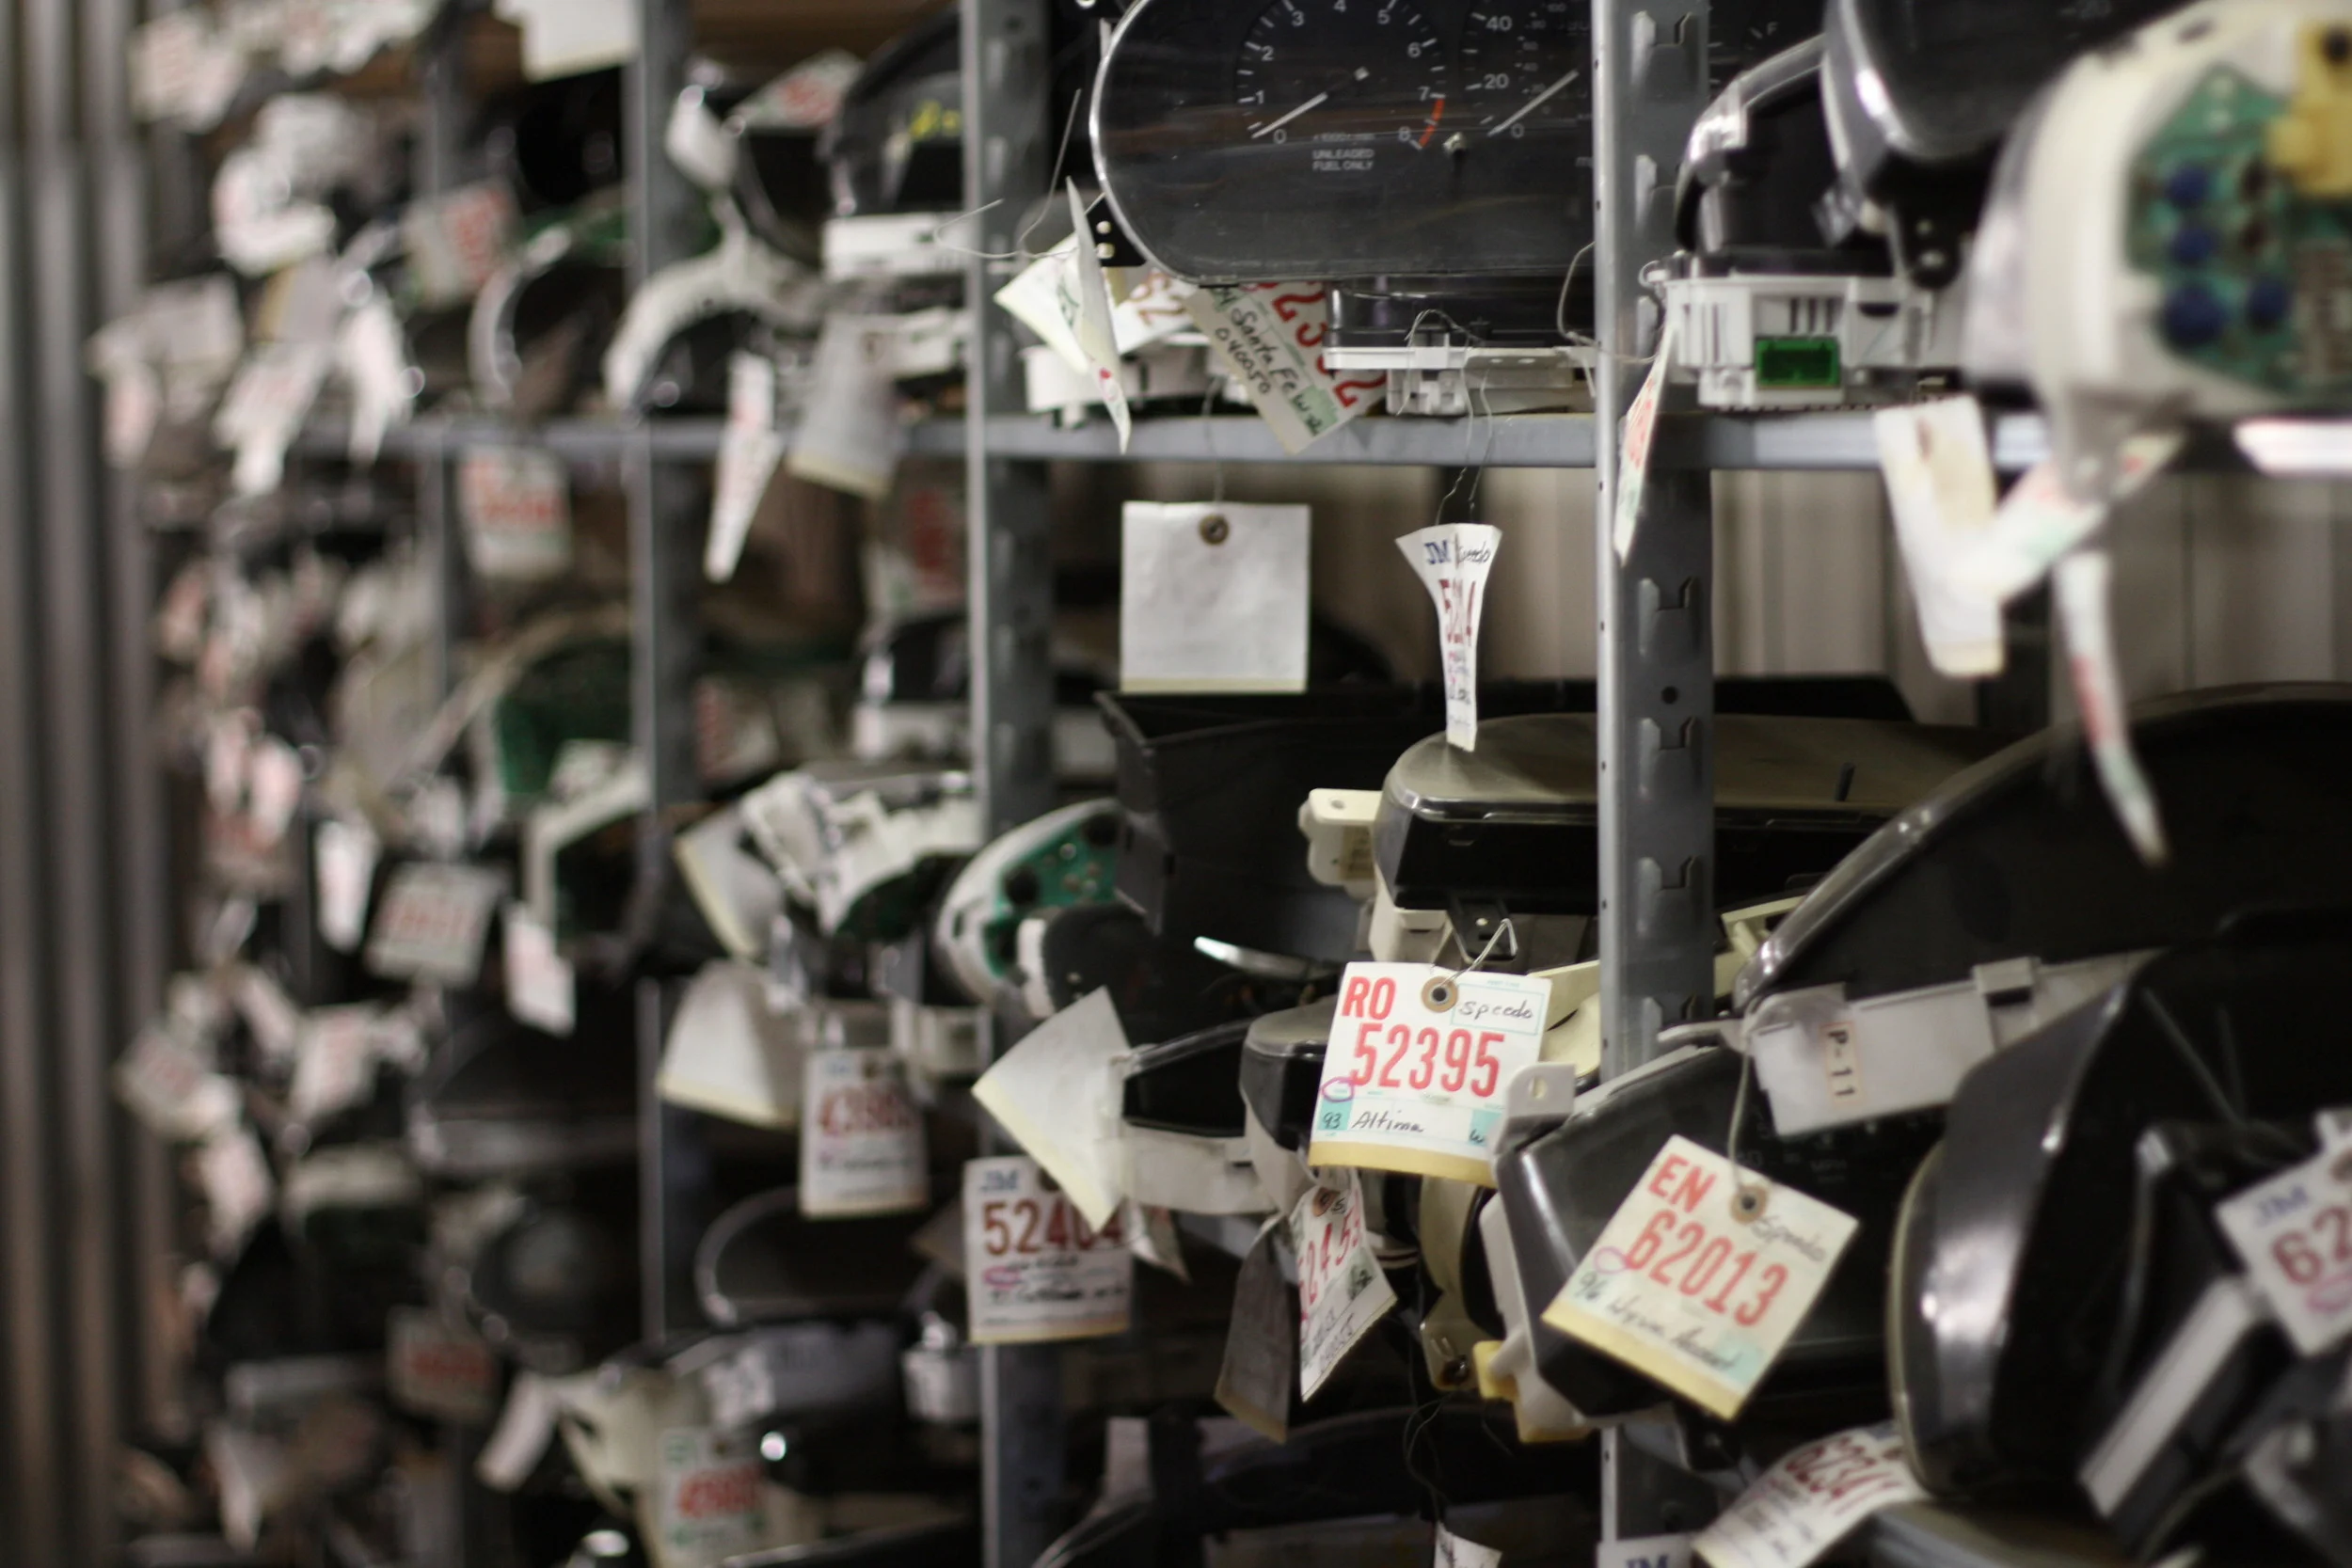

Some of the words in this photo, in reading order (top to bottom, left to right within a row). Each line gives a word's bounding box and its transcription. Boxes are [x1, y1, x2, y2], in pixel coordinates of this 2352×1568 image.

[1292, 11, 1305, 26] 3
[1377, 9, 1390, 25] 5
[1486, 15, 1513, 31] 40
[1262, 46, 1275, 61] 2
[1407, 43, 1421, 58] 6
[1484, 73, 1510, 89] 20
[1255, 89, 1264, 104] 1
[1418, 87, 1430, 102] 7
[1273, 128, 1286, 144] 0
[1398, 126, 1411, 141] 8
[1511, 123, 1524, 138] 0
[1312, 148, 1375, 160] UNLEADED
[1312, 160, 1341, 171] FUEL
[1342, 160, 1375, 171] ONLY
[1231, 307, 1279, 366] Santa
[1270, 367, 1299, 396] Fe
[1342, 975, 1397, 1021] RO
[1349, 1022, 1505, 1098] 52395
[1647, 1153, 1717, 1214] EN
[1624, 1209, 1789, 1327] 62013
